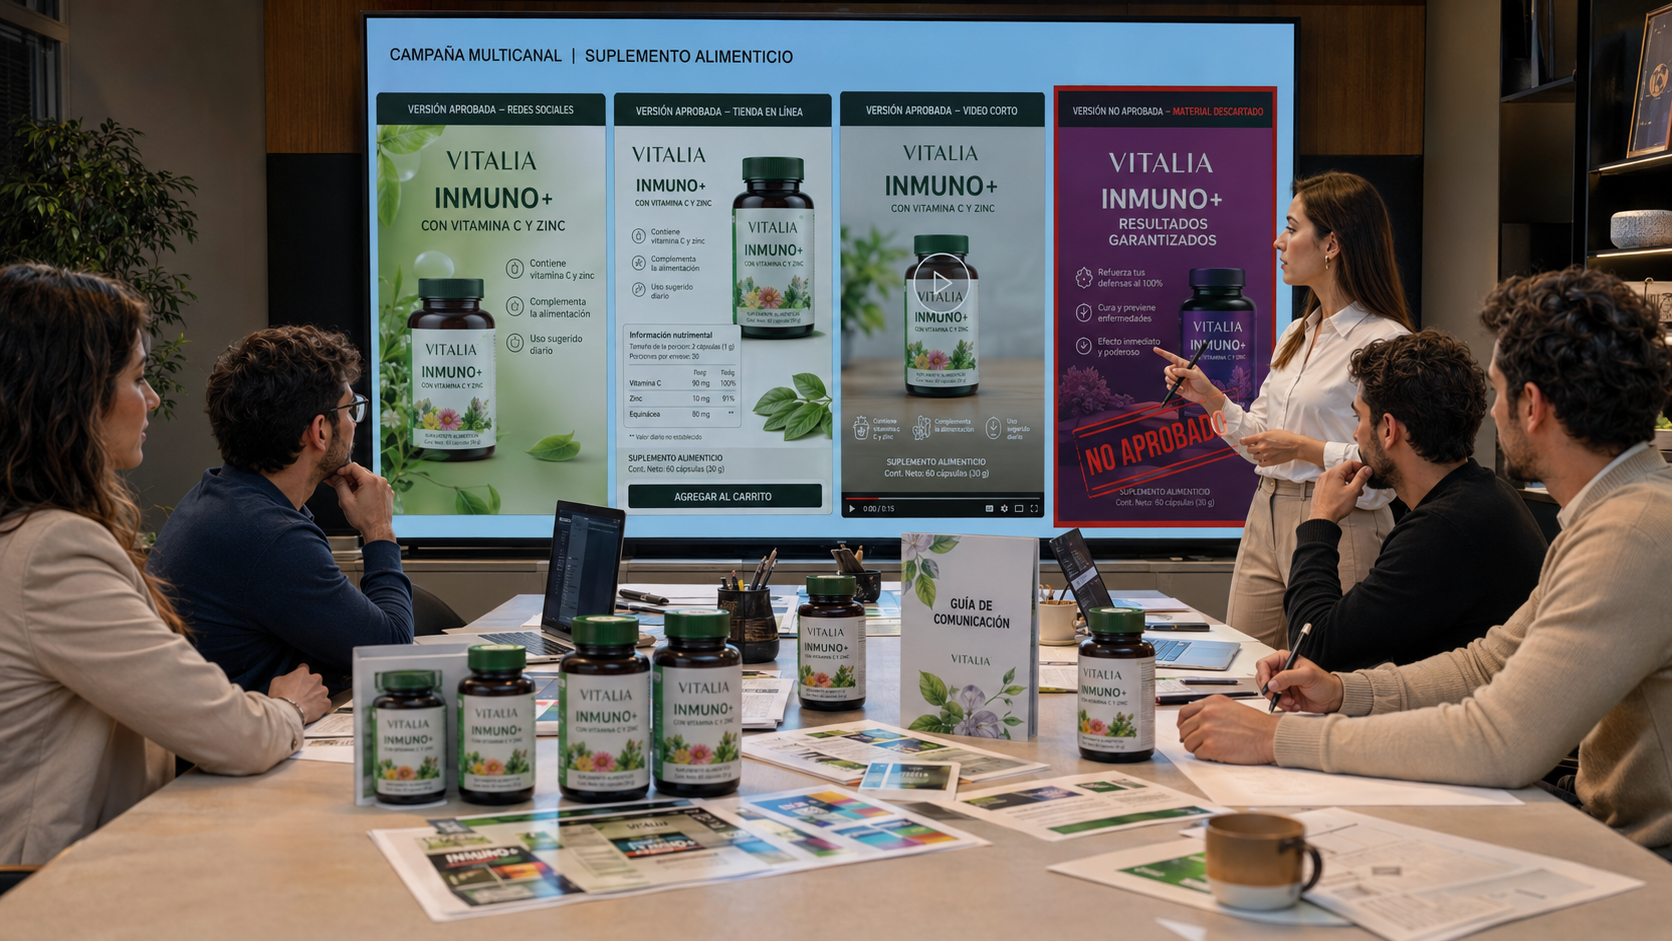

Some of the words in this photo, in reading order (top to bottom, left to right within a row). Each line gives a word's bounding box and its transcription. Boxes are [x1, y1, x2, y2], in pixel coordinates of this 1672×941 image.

[390, 46, 465, 61] CAMPAÑA
[469, 48, 562, 62] MULTICANAL
[585, 50, 690, 63] SUPLEMENTO
[695, 50, 793, 63] ALIMENTICIO
[408, 103, 447, 114] VERSIÓN
[449, 105, 496, 114] APROBADA
[508, 105, 533, 114] REDES
[535, 105, 574, 114] SOCIALES
[636, 105, 673, 115] VERSIÓN
[675, 107, 722, 116] APROBADA
[733, 107, 763, 116] TIENDA
[766, 107, 776, 116] EN
[779, 105, 803, 116] LÍNEA
[866, 104, 902, 115] VERSIÓN
[905, 106, 952, 115] APROBADA
[963, 106, 988, 115] VIDEO
[990, 106, 1017, 115] CORTO
[1073, 105, 1106, 115] VERSIÓN
[1108, 107, 1120, 115] NO
[1122, 107, 1163, 116] APROBADA
[1173, 107, 1212, 116] MATERIAL
[1214, 107, 1264, 116] DESCARTADO
[632, 147, 706, 163] VITALIA
[903, 145, 978, 161] VITALIA
[446, 151, 537, 170] VITALIA
[1109, 153, 1213, 173] VITALIA
[636, 179, 706, 192] INMUNO+
[886, 175, 997, 196] INMUNO+
[435, 187, 552, 208] INMUNO+
[1102, 188, 1222, 209] INMUNO+
[891, 204, 910, 213] CON
[913, 204, 955, 213] VITAMINA
[958, 204, 964, 213] C
[966, 204, 972, 213] Y
[974, 204, 995, 213] ZINC
[421, 220, 447, 231] CON
[451, 220, 510, 231] VITAMINA
[514, 220, 522, 231] C
[526, 220, 533, 231] Y
[536, 220, 566, 231] ZINC
[748, 222, 798, 234] VITALIA
[1119, 218, 1208, 230] RESULTADOS
[1109, 234, 1217, 246] GARANTIZADOS
[745, 244, 803, 256] INMUNO+
[530, 259, 566, 267] Contiene
[651, 255, 696, 264] Complementa
[530, 271, 564, 280] vitamina
[566, 272, 571, 280] C
[579, 272, 594, 280] zinc
[666, 284, 693, 292] sugerido
[917, 292, 963, 302] VITALIA
[530, 298, 586, 308] Complementa
[1124, 304, 1156, 313] previene
[530, 309, 537, 318] la
[539, 309, 590, 318] alimentación
[915, 312, 968, 323] INMUNO+
[1193, 321, 1242, 332] VITALIA
[548, 335, 582, 344] sugerido
[426, 344, 477, 355] VITALIA
[530, 347, 553, 355] diario
[421, 366, 482, 378] INMUNO+
[1085, 444, 1116, 476] NO
[1121, 410, 1228, 466] APROBADO
[887, 458, 936, 466] SUPLEMENTO
[938, 458, 986, 466] ALIMENTICIO
[982, 470, 989, 478] g)
[674, 493, 717, 501] AGREGAR
[719, 493, 730, 501] AL
[733, 493, 772, 501] CARRITO
[950, 596, 975, 611] GUÍA
[979, 599, 992, 611] DE
[934, 614, 1010, 629] COMUNICACIÓN
[807, 627, 844, 637] VITALIA
[805, 642, 848, 652] INMUNO+
[951, 654, 991, 666] VITALIA
[1083, 668, 1122, 680] VITALIA
[678, 682, 730, 694] VITALIA
[1082, 685, 1126, 697] INMUNO+
[580, 689, 632, 702] VITALIA
[475, 708, 518, 719] VITALIA
[674, 703, 734, 716] INMUNO+
[576, 710, 638, 723] INMUNO+
[387, 720, 430, 729] VITALIA
[472, 725, 522, 736] INMUNO+
[384, 735, 433, 745] INMUNO+
